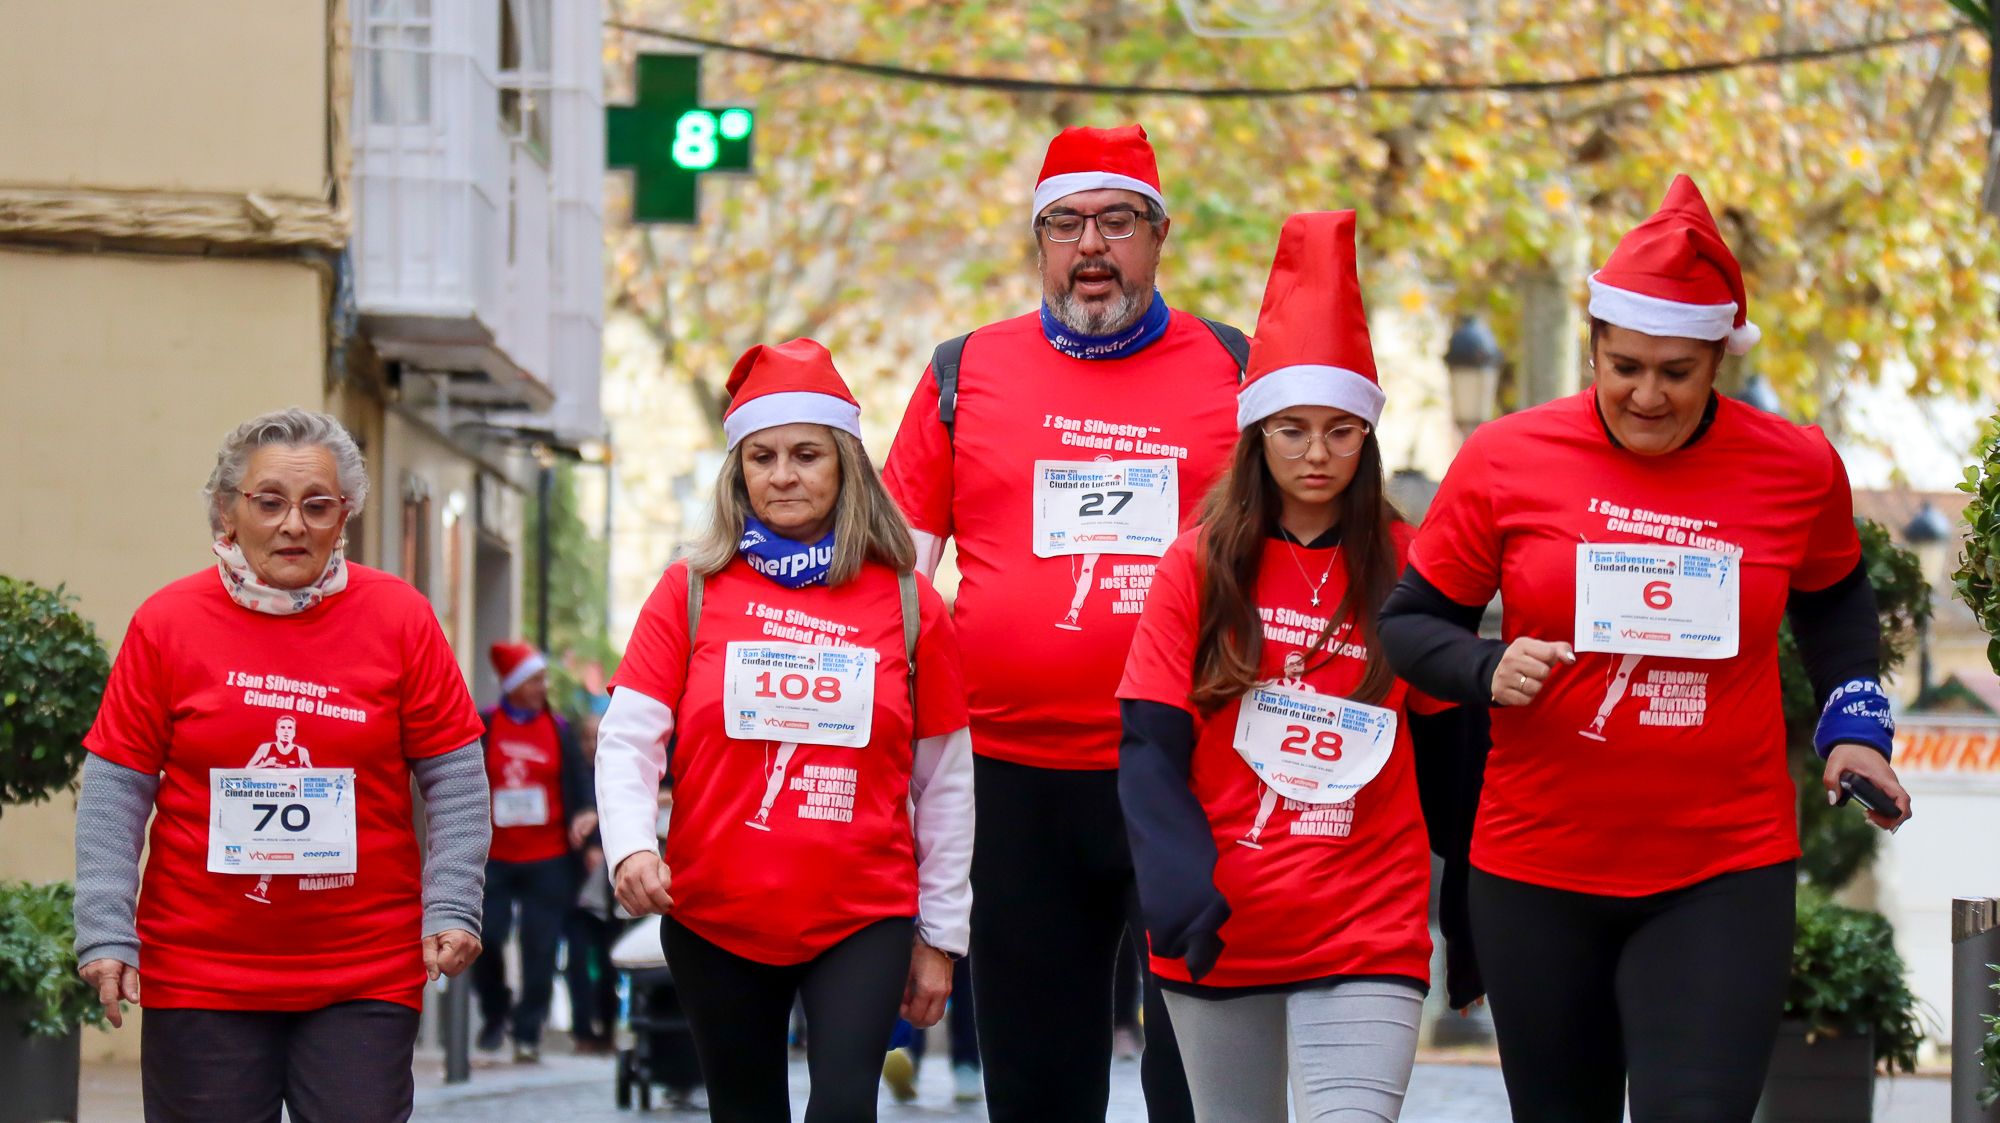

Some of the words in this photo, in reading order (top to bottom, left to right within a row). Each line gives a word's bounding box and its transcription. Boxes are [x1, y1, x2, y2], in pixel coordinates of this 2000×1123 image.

[1043, 415, 1052, 427] I
[1054, 416, 1081, 431] San
[1084, 419, 1147, 438] Silvestre
[1062, 431, 1112, 449] Ciudad
[1115, 438, 1133, 452] de
[1136, 440, 1188, 459] Lucena
[1068, 473, 1103, 481] Silvestre
[1050, 481, 1078, 489] Ciudad
[1079, 491, 1133, 517] 27
[1588, 498, 1599, 513] I
[1600, 501, 1630, 520] San
[1632, 508, 1703, 532] Silvestre
[1074, 534, 1093, 542] vtv
[1126, 534, 1162, 543] enerplus
[1607, 518, 1664, 539] Ciudad
[1666, 527, 1686, 545] de
[748, 546, 835, 578] enerplu
[1595, 555, 1612, 563] San
[1615, 555, 1655, 565] Silvestre
[1113, 564, 1157, 576] MEMOR
[1594, 564, 1626, 572] Ciudad
[1628, 564, 1639, 573] de
[1642, 564, 1674, 575] Lucena
[1100, 577, 1127, 589] JOSE
[1643, 581, 1673, 610] 6
[745, 602, 755, 616] I
[756, 604, 783, 621] San
[785, 610, 847, 637] Silvestre
[763, 621, 812, 645] Ciudad
[1263, 623, 1306, 646] iudad
[1620, 629, 1643, 639] vtv
[1680, 633, 1721, 642] enerplus
[760, 651, 796, 661] Silvestre
[742, 658, 771, 667] Ciudad
[784, 660, 814, 670] Lucena
[226, 671, 235, 685] I
[237, 672, 263, 688] San
[265, 675, 327, 698] Silvestre
[1648, 670, 1709, 684] MEMORIAL
[755, 671, 842, 703] 108
[1631, 683, 1660, 697] JOSE
[1662, 685, 1706, 698] CARLOS
[244, 690, 294, 710] Ciudad
[296, 697, 316, 713] de
[317, 701, 366, 723] Lucena
[1260, 693, 1276, 705] San
[1278, 697, 1316, 713] Silvestre
[1650, 698, 1706, 712] HURTADO
[1258, 703, 1288, 716] Ciudad
[1290, 708, 1300, 718] de
[1302, 711, 1333, 725] Lucena
[1640, 711, 1704, 726] MARJALIZO
[764, 717, 784, 727] vtv
[818, 721, 855, 731] enerplus
[1280, 725, 1343, 761] 28
[803, 765, 858, 782] MEMORIAL
[1271, 772, 1293, 783] vtv
[242, 780, 277, 789] Silvestre
[789, 777, 816, 792] JOSE
[817, 779, 856, 796] CARLOS
[225, 789, 253, 798] Ciudad
[255, 789, 264, 798] de
[266, 789, 296, 798] Lucena
[806, 792, 854, 809] HURTADO
[252, 804, 311, 832] 70
[798, 805, 853, 823] MARJALIZO
[1300, 809, 1354, 823] HURTADO
[1290, 821, 1351, 837] MARJALIZO
[249, 852, 268, 861] vtv
[303, 850, 341, 859] enerplus
[299, 874, 354, 891] MARJALIZO
